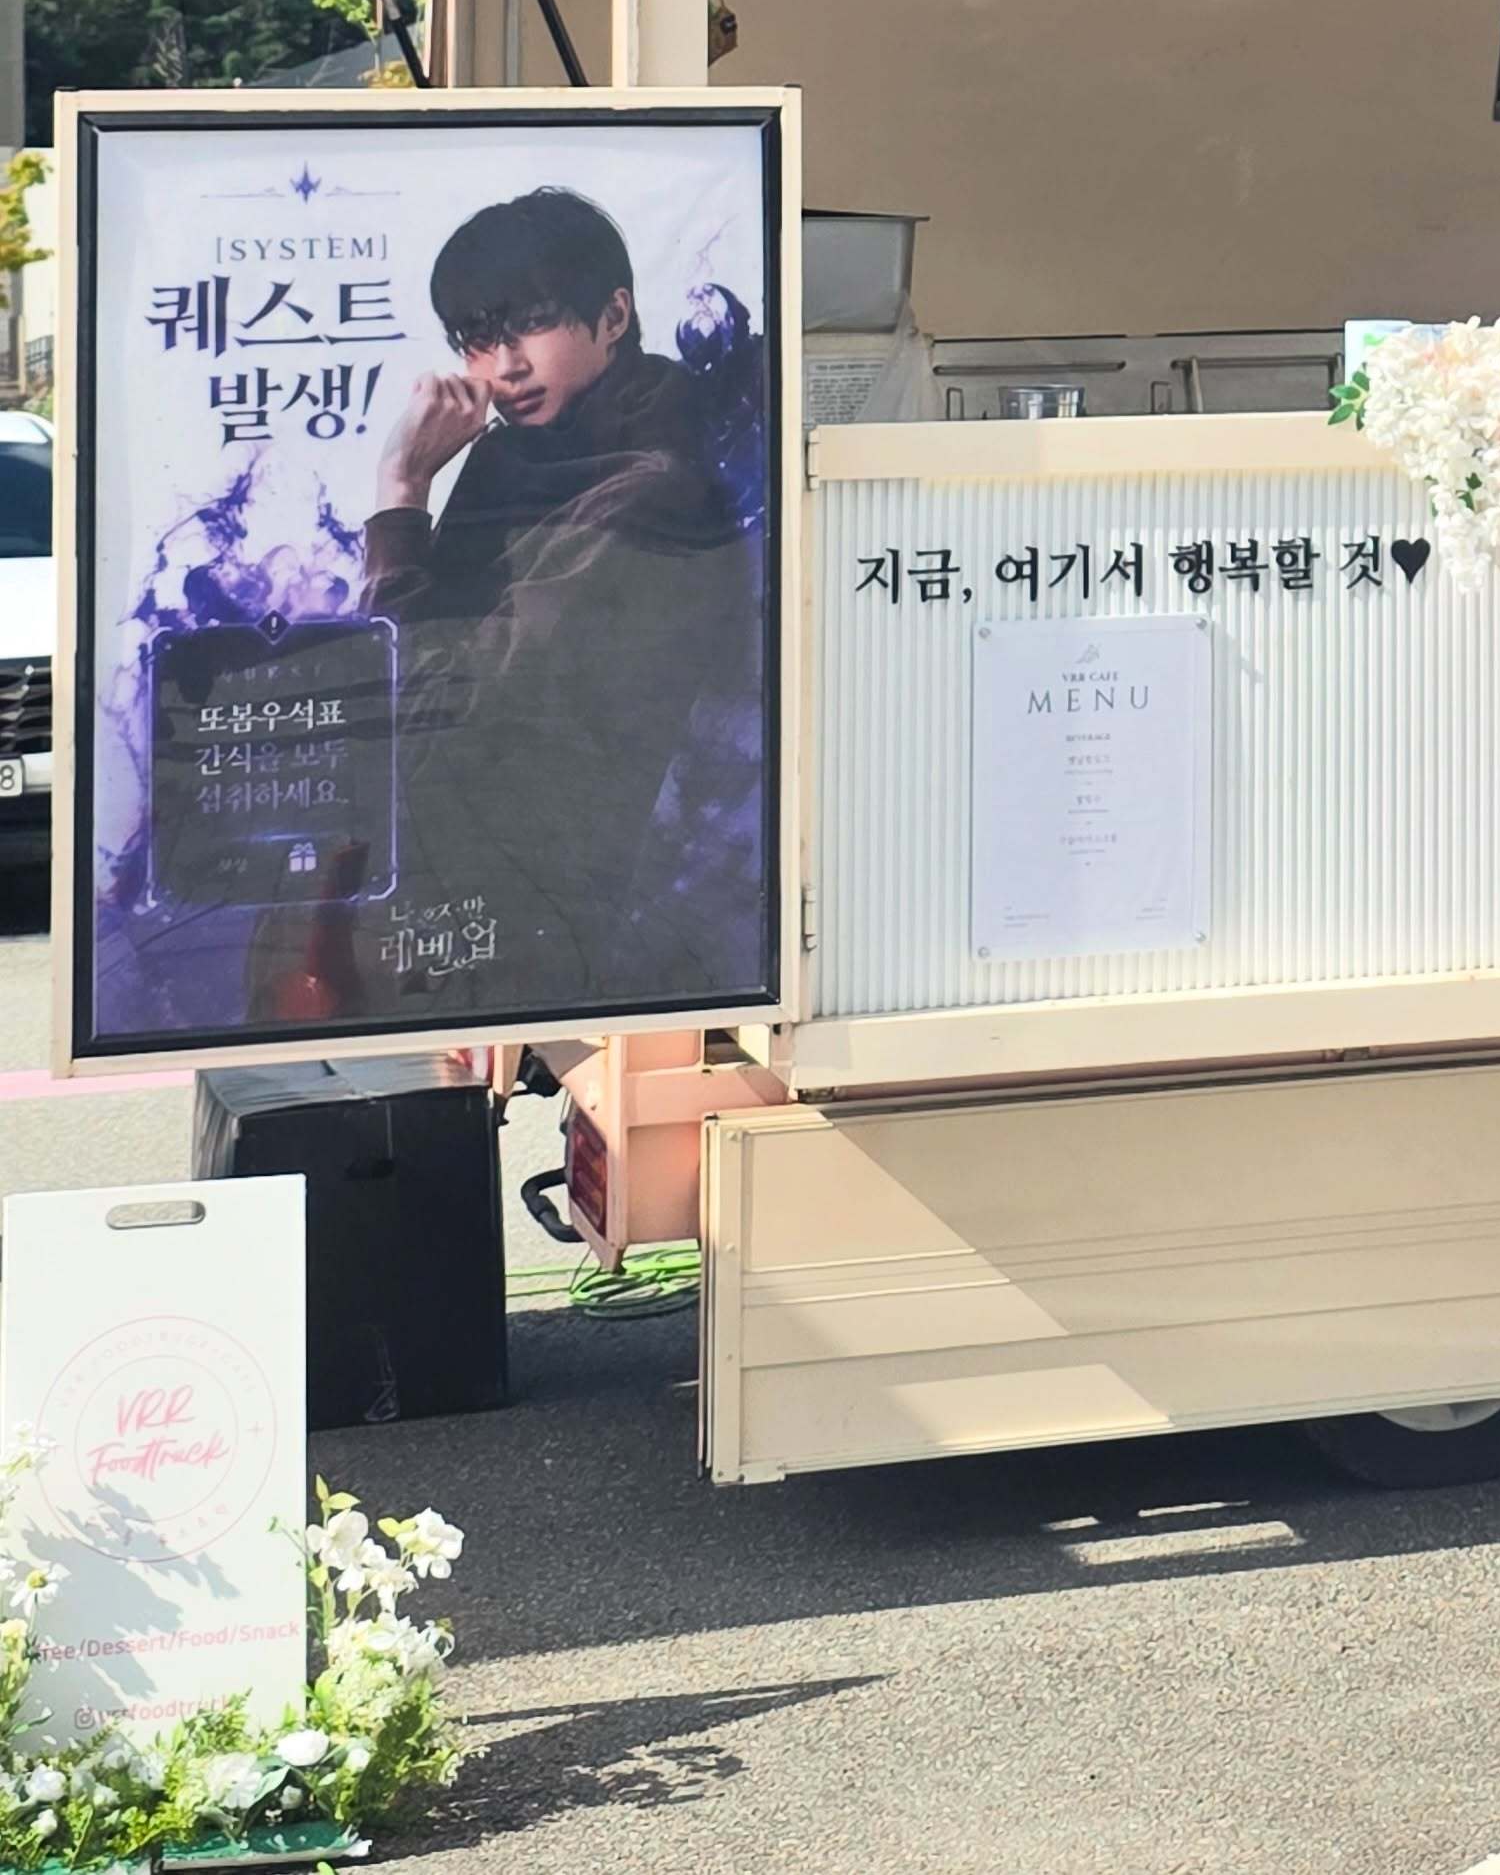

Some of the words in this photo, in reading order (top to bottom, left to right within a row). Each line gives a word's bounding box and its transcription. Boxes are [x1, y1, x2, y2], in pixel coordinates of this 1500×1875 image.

[144, 274, 408, 359] 퀘스트
[209, 362, 384, 451] 발생!
[855, 547, 972, 605] 지금,
[995, 541, 1144, 602] 여기서
[1168, 536, 1321, 594] 행복할
[1027, 685, 1149, 715] MENU
[116, 1383, 197, 1438] VRR
